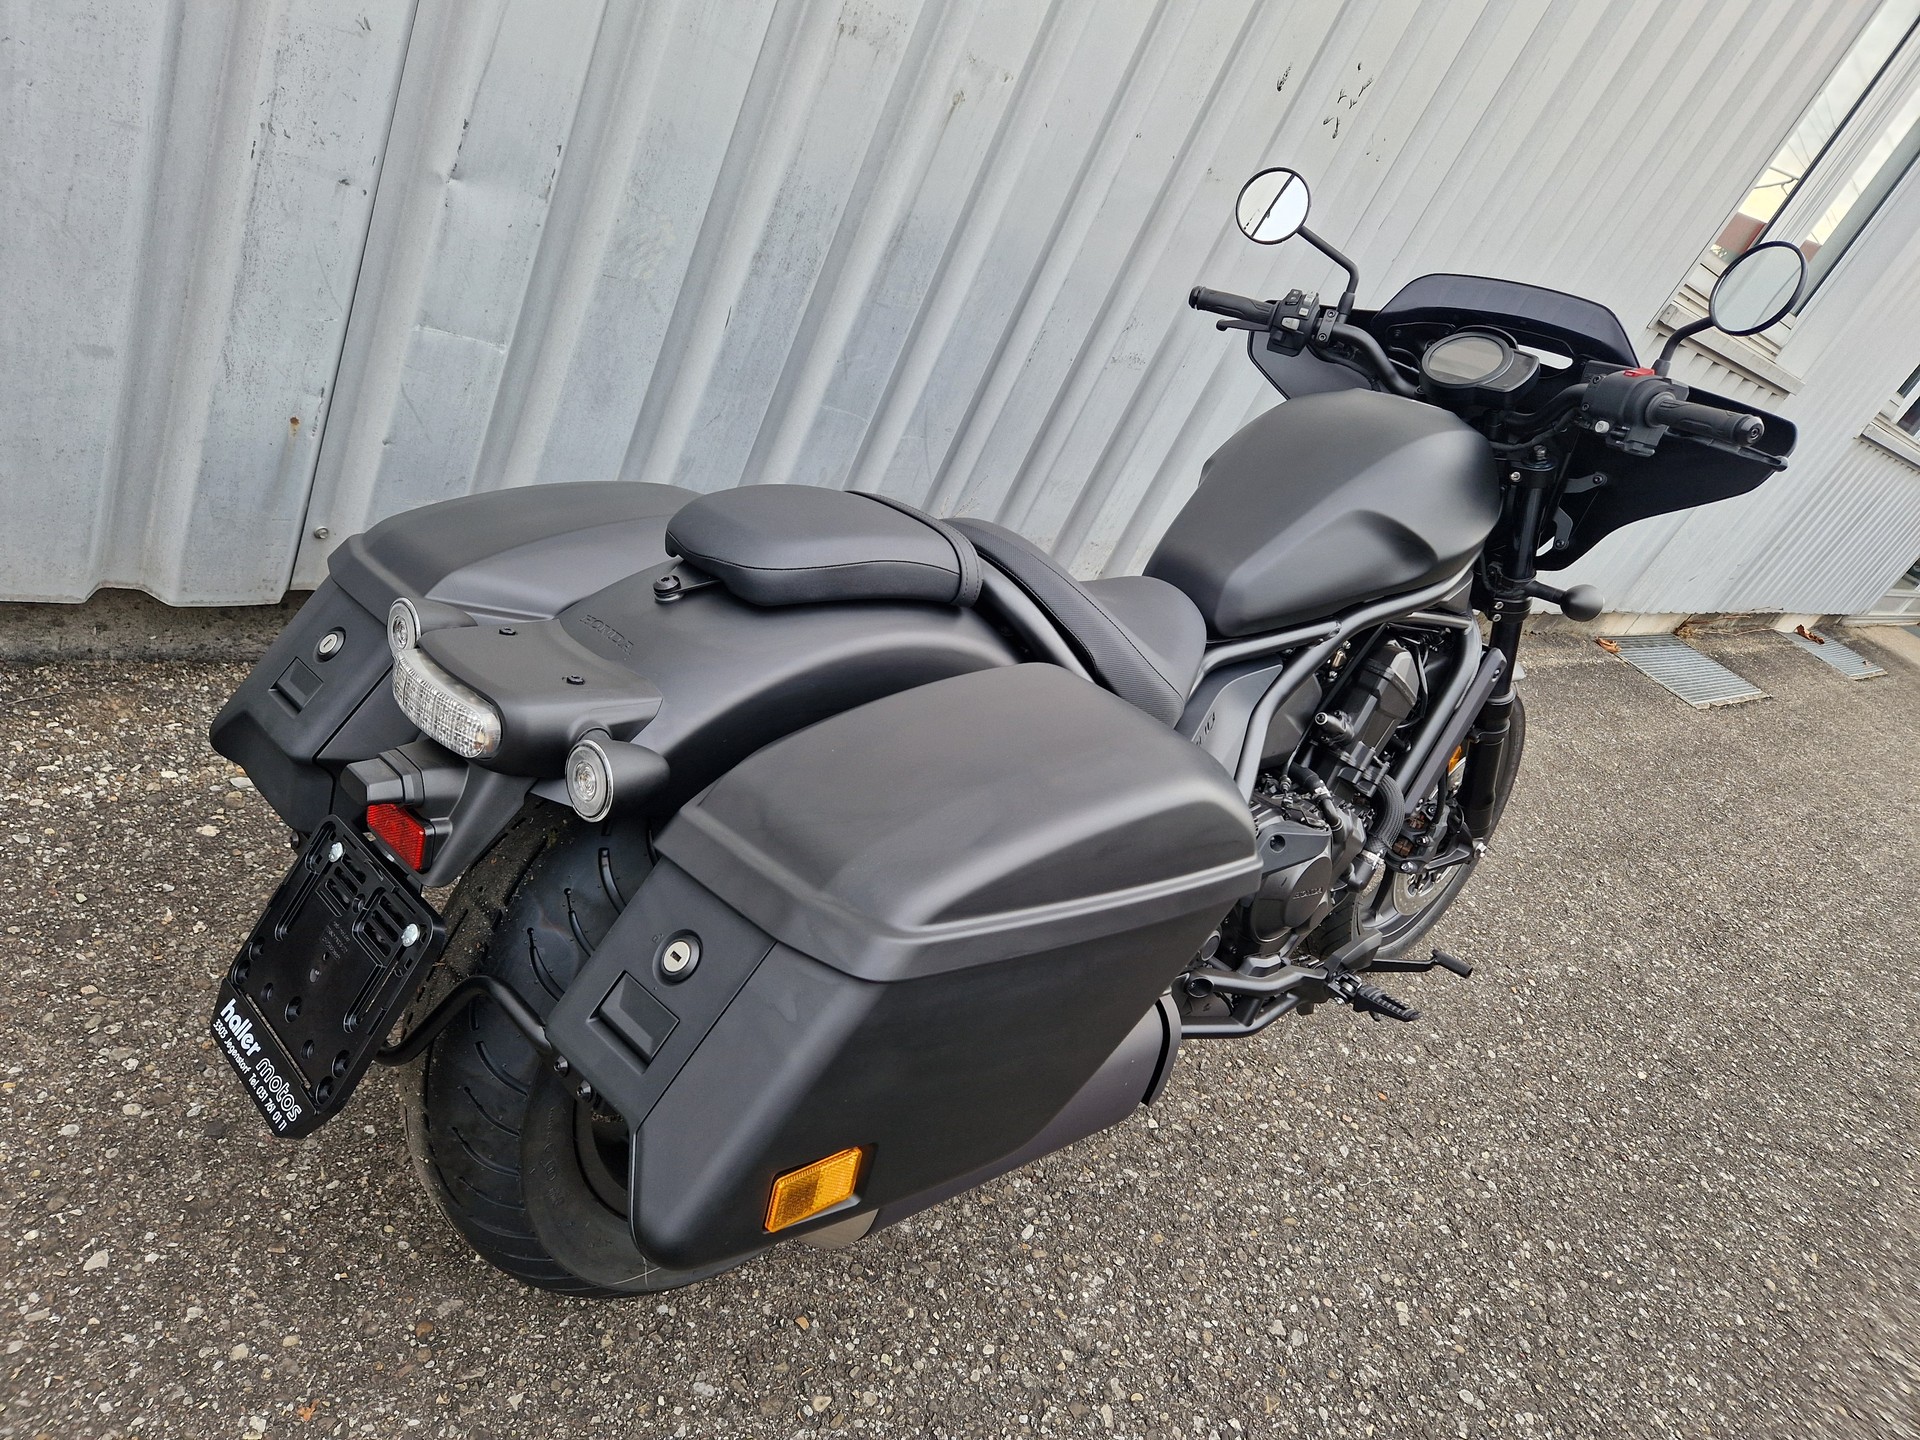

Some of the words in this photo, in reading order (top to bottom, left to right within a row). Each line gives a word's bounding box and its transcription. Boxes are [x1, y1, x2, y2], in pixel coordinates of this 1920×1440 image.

[579, 614, 634, 656] HONDA
[213, 1019, 229, 1039] 3303
[224, 1037, 252, 1074] Jegenstorf
[248, 1073, 260, 1090] Tel.
[256, 1085, 269, 1102] 031
[264, 1099, 277, 1114] 761
[272, 1111, 282, 1124] 01
[278, 1119, 288, 1132] 11
[220, 998, 261, 1056] haller
[256, 1057, 302, 1122] motos
